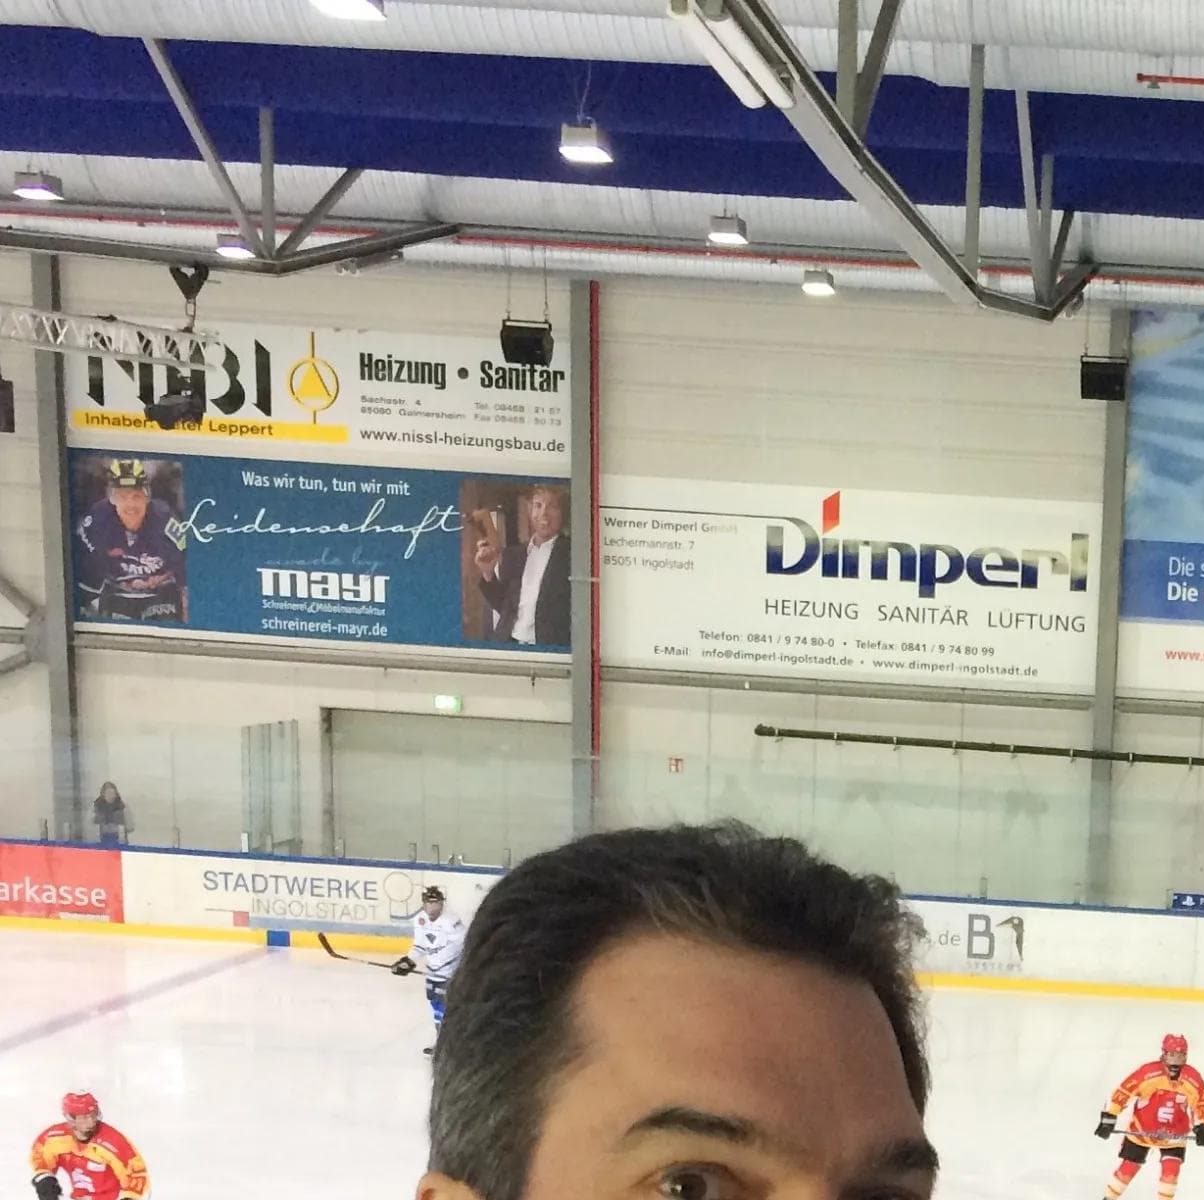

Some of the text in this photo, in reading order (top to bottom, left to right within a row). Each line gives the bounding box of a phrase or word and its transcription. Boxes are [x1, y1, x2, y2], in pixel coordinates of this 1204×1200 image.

[360, 352, 446, 390] Heizung
[209, 420, 273, 436] Leppert
[360, 429, 565, 452] www.nissl-heizungsbau.de
[242, 471, 411, 496] Was wir tun, tun wir mit
[180, 498, 464, 559] Leidenschaft
[604, 517, 648, 529] Werner
[652, 519, 698, 533] Dimperl
[689, 540, 696, 550] 7
[766, 490, 1089, 598] Dimperl
[603, 554, 695, 572] 85051 Ingolstadt
[1169, 556, 1195, 577] Die
[256, 568, 391, 603] mayr
[1167, 582, 1198, 602] Die
[765, 598, 1086, 633] HEIZUNG SANITÄR LÜFTUNG
[261, 617, 388, 638] schreinerei-mayr.de
[747, 633, 773, 643] 0841
[784, 635, 791, 645] 9
[795, 636, 807, 646] 74
[810, 637, 835, 648] 80-0
[901, 642, 927, 652] 0841
[938, 644, 945, 654] 9
[964, 646, 978, 656] 80
[981, 646, 995, 657] 99
[702, 649, 854, 666] info@dimperl-ingolstadt.de
[0, 876, 107, 908] arkasse
[203, 870, 378, 901] STADTWERKE
[252, 898, 378, 921] INGOLSTADT
